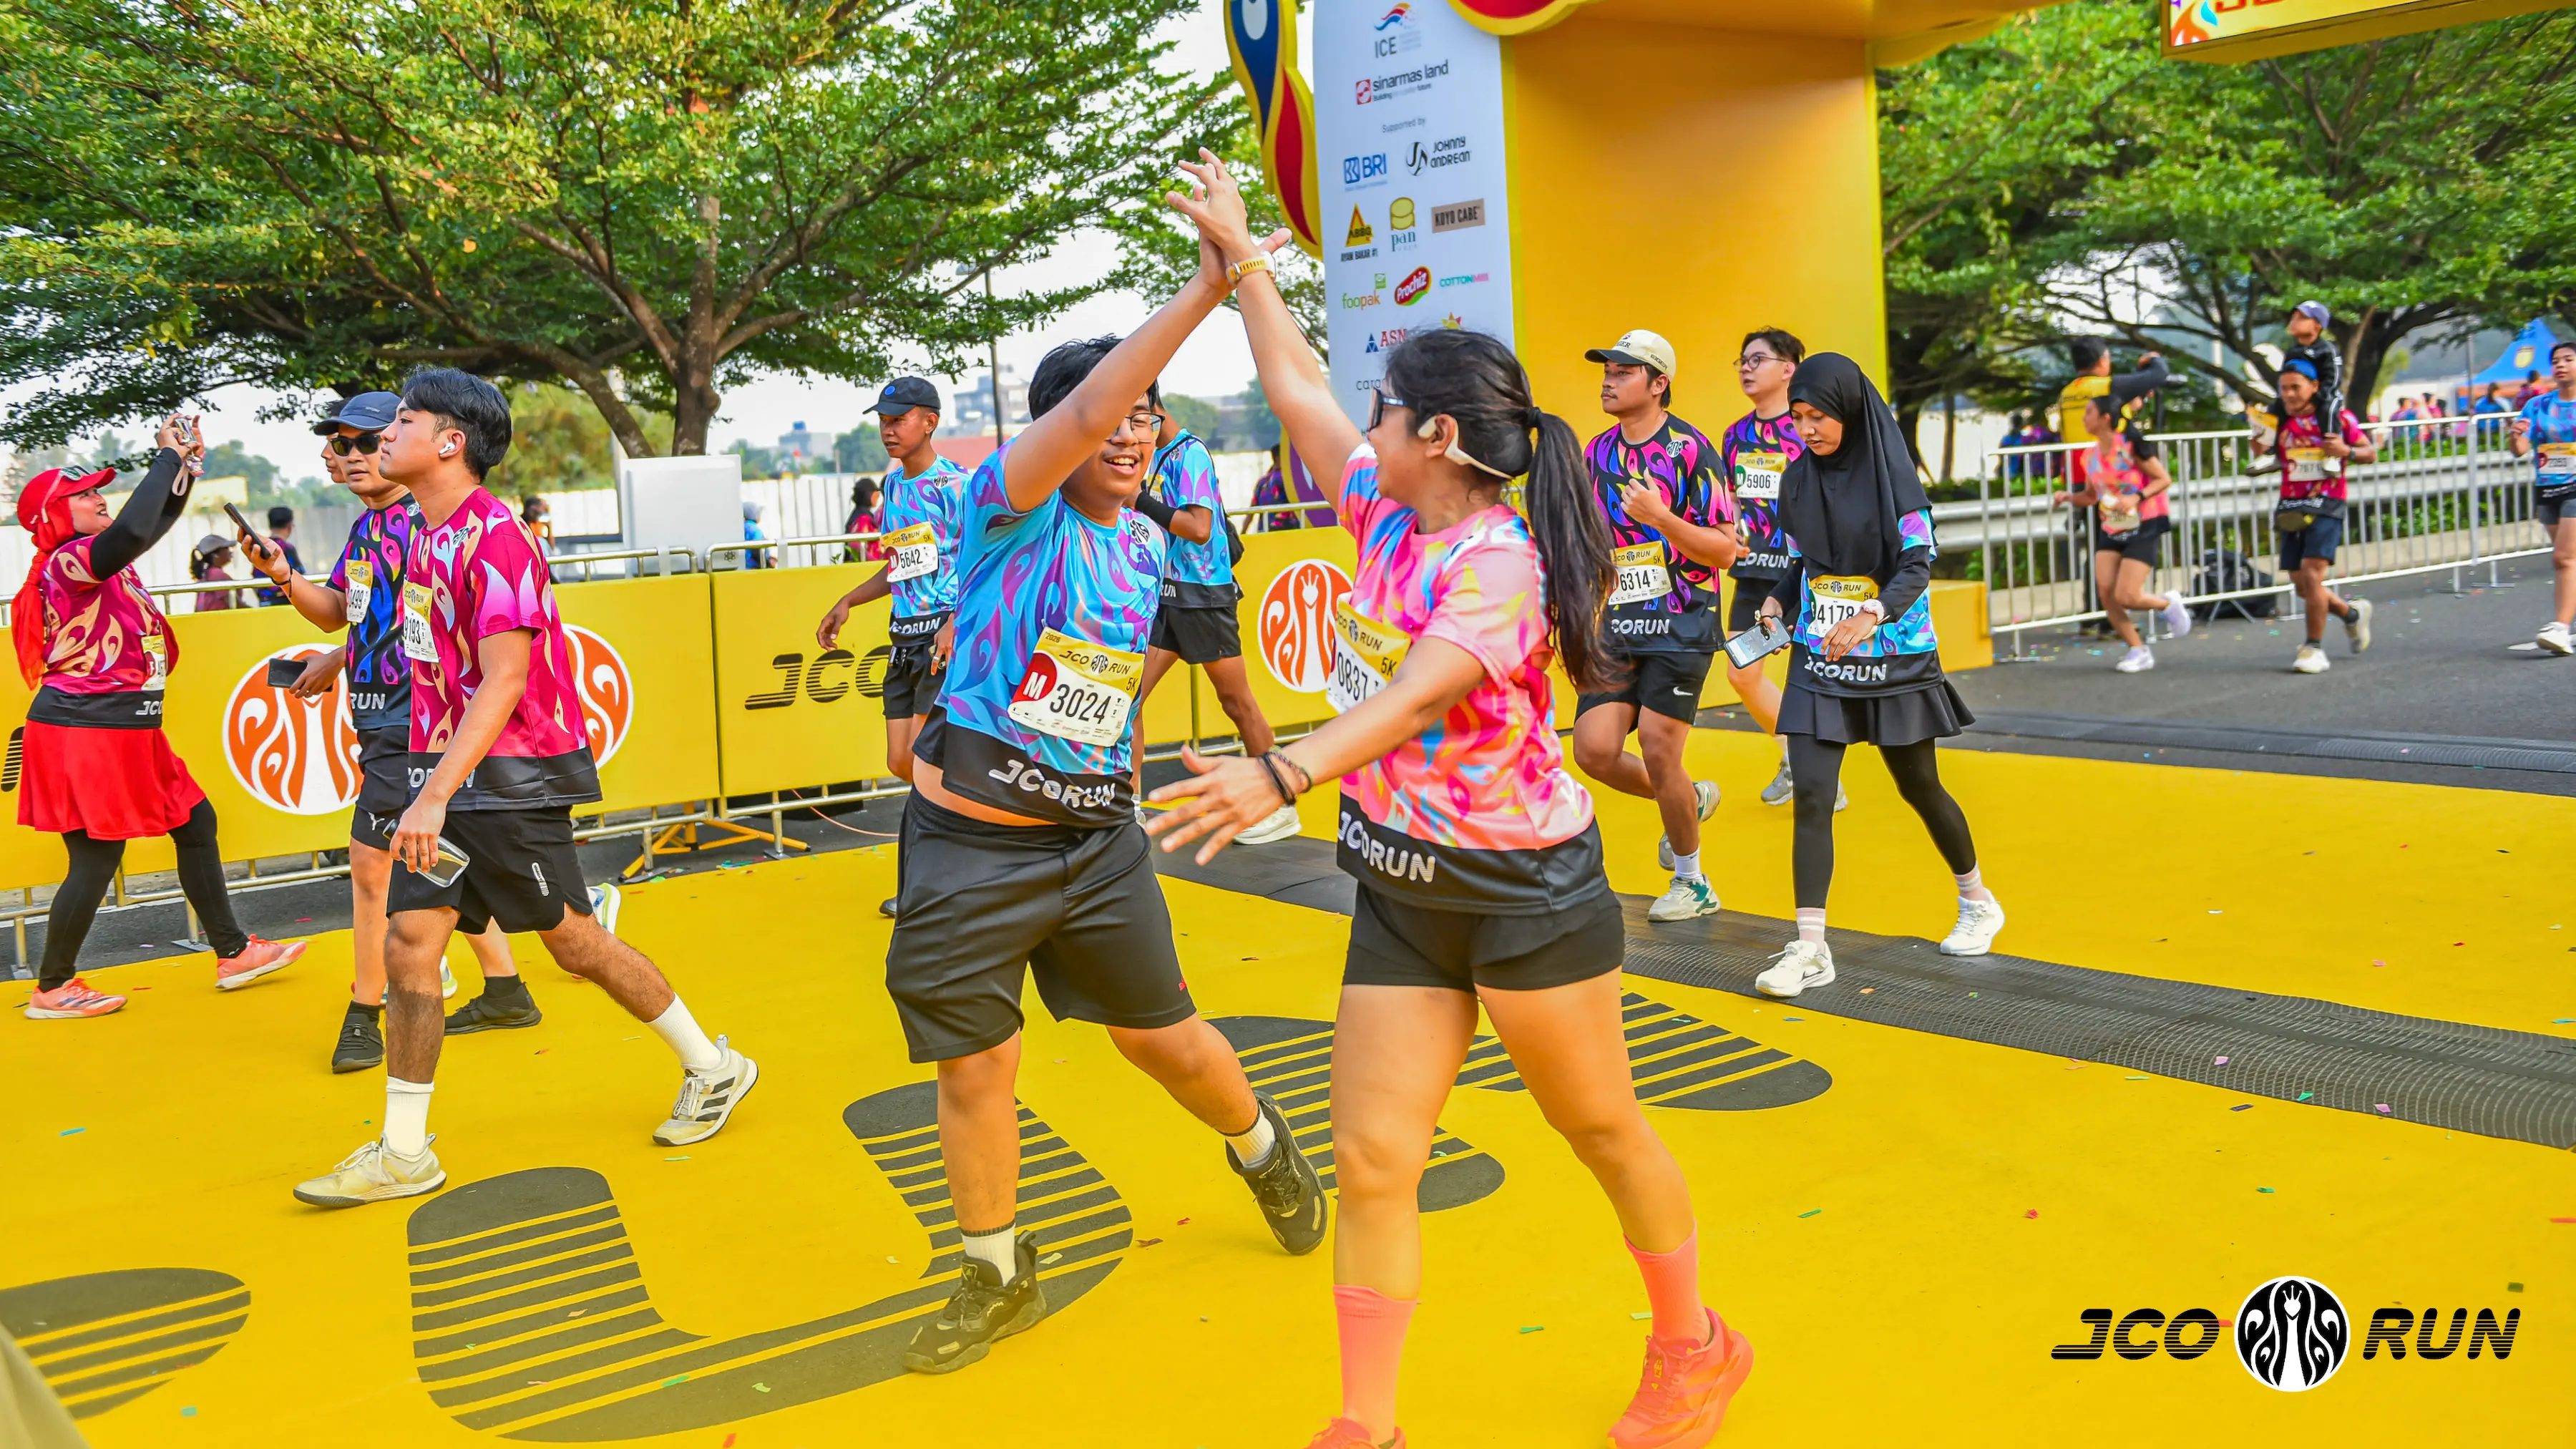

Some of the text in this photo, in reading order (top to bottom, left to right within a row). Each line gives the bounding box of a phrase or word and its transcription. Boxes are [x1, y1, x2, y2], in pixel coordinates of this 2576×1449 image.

[1375, 36, 1397, 59] ICE
[1372, 59, 1449, 92] sinarmas land
[1382, 117, 1425, 134] Supported by
[1362, 152, 1387, 178] BRI
[1435, 206, 1478, 227] KOYO CABE
[1391, 230, 1416, 251] pan
[1397, 271, 1428, 301] Prochiz
[1342, 289, 1381, 310] foopak
[1356, 378, 1385, 391] caro
[1737, 473, 1771, 489] M 5906
[907, 530, 920, 539] RUN
[923, 534, 932, 542] 5K
[899, 549, 923, 569] 5642
[1636, 550, 1651, 559] RUN
[1653, 555, 1662, 564] 5K
[1619, 570, 1651, 592] 6314
[1863, 592, 1874, 600] 5K
[1818, 604, 1855, 625] 4178
[404, 616, 421, 644] 9193
[1360, 632, 1383, 651] RUN
[1059, 650, 1131, 675] JCO RUN
[1381, 657, 1397, 677] 5K
[1126, 677, 1138, 691] 5K
[1337, 652, 1368, 701] 0837
[1023, 671, 1048, 700] M
[1050, 683, 1111, 724] 3024
[988, 759, 1116, 808] JCORUN
[1338, 811, 1436, 883] JCORUN
